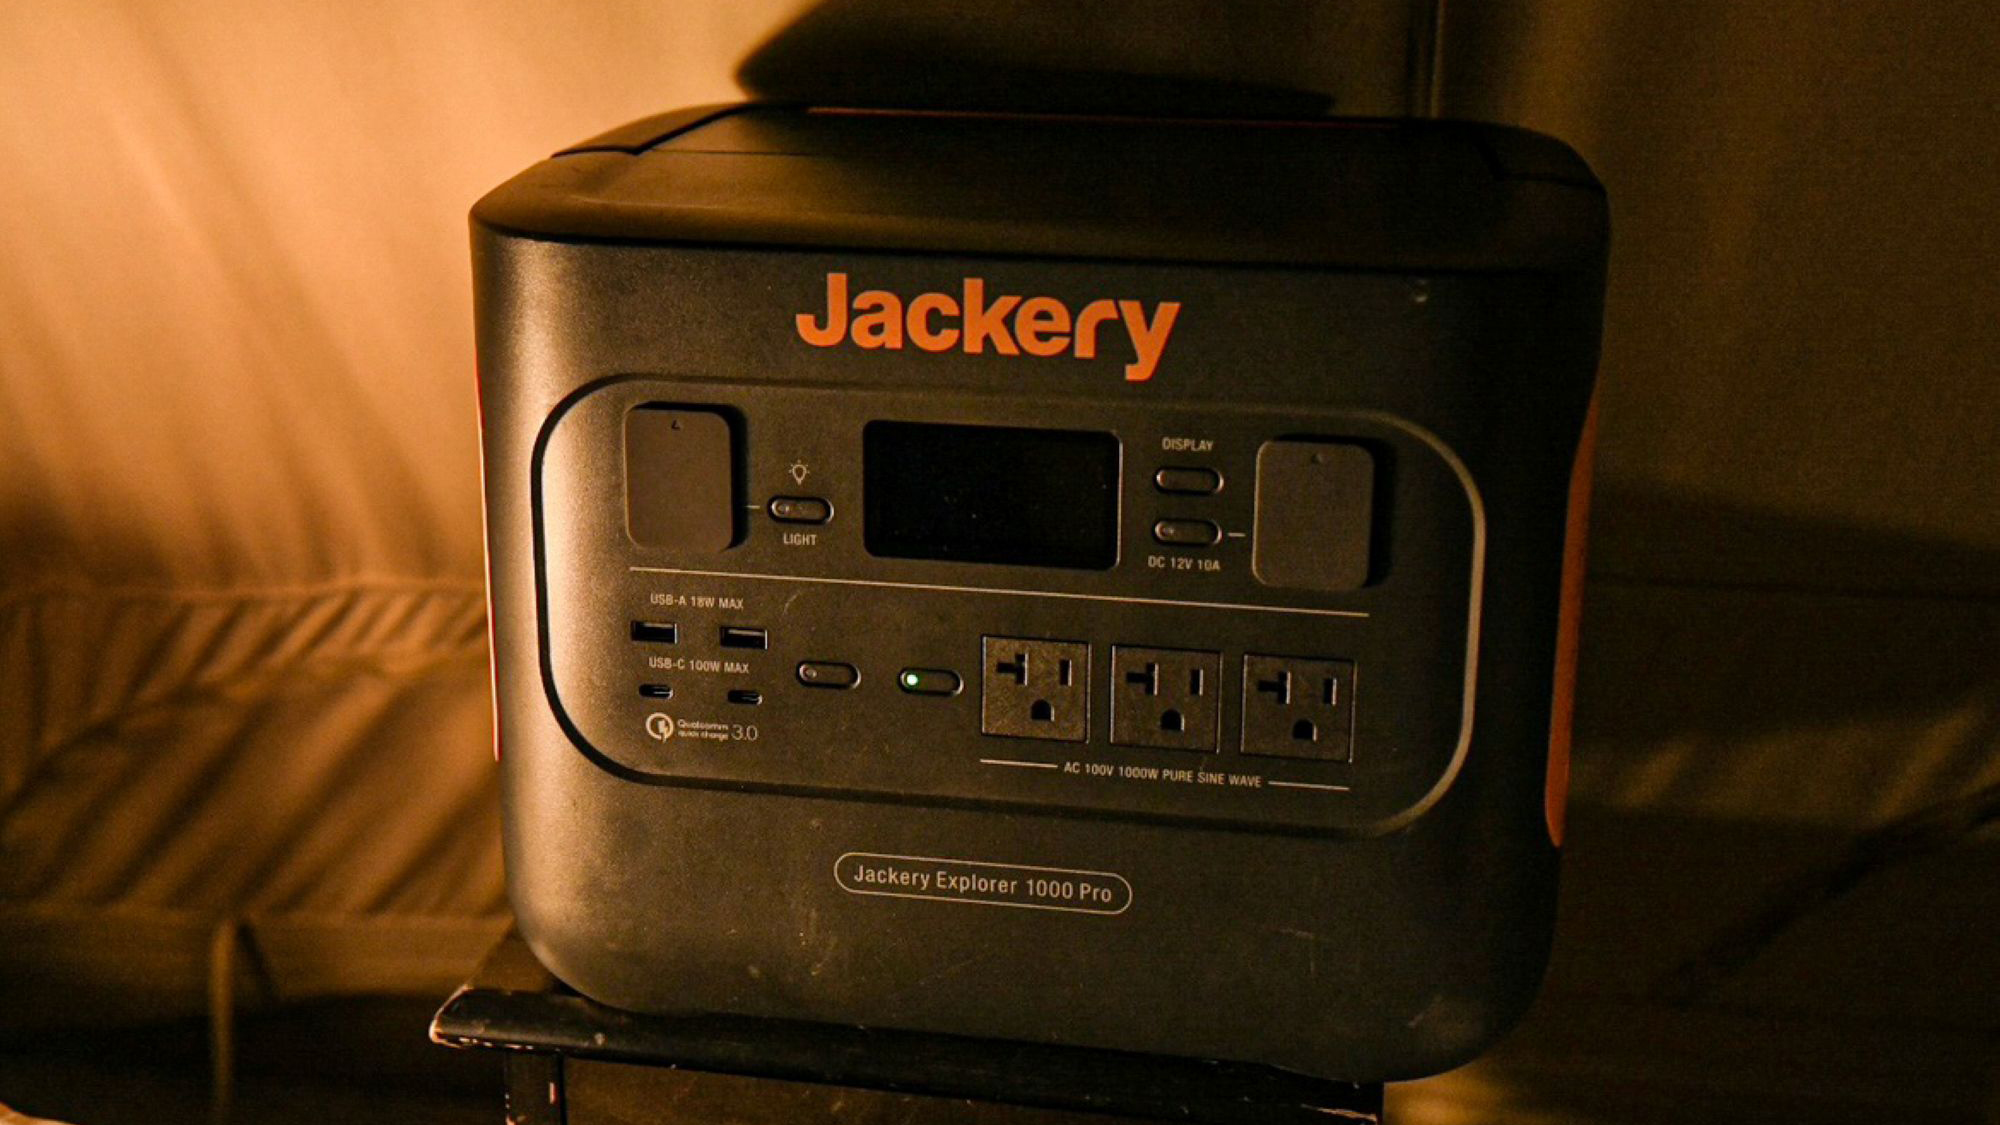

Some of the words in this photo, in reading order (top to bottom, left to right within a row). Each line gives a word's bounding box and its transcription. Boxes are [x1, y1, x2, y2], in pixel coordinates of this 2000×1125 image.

[796, 272, 1181, 382] Jackery
[1162, 436, 1213, 451] DISPLAY
[783, 532, 818, 545] LIGHT
[1148, 555, 1165, 568] DC
[1171, 557, 1193, 570] 12V
[1198, 559, 1221, 571] 10A
[650, 592, 687, 606] USB-A
[691, 596, 715, 608] 18W
[718, 598, 744, 610] MAX
[648, 656, 685, 671] USB-C
[690, 659, 720, 672] 100W
[724, 661, 749, 674] MAX
[731, 723, 759, 742] 3.0
[1064, 761, 1080, 774] AC
[1085, 763, 1114, 776] 100V
[1119, 765, 1159, 780] 1000W
[1162, 768, 1193, 783] PURE
[1197, 771, 1226, 785] SINE
[1227, 773, 1262, 788] WAVE
[853, 864, 931, 891] Jackery
[936, 870, 1018, 894] Explorer
[1026, 879, 1073, 900] 1000
[1078, 882, 1112, 904] Pro
